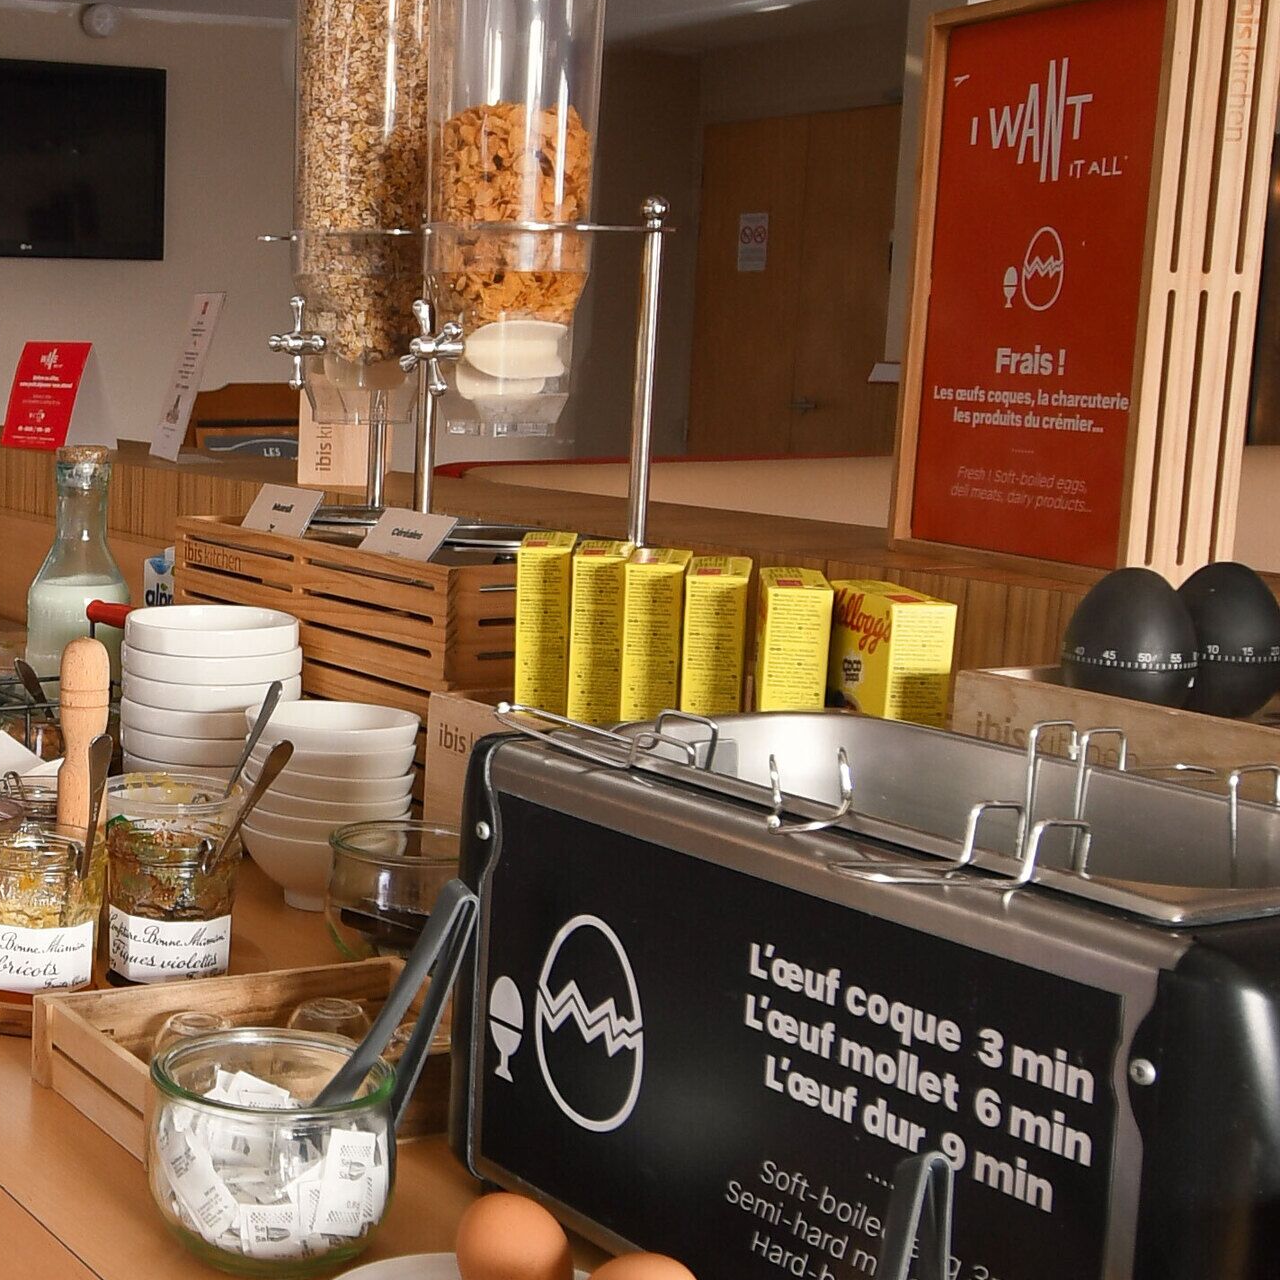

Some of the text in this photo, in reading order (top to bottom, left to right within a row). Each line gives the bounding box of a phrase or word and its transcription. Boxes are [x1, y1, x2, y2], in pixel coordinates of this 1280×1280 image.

[970, 57, 1093, 183] I WANT
[1069, 159, 1085, 179] IT
[995, 345, 1053, 376] Frais
[933, 385, 954, 401] Les
[955, 387, 986, 403] œufs
[987, 389, 1036, 408] coques,
[1037, 389, 1050, 406] la
[953, 406, 971, 423] les
[972, 408, 1023, 429] produits
[1024, 411, 1041, 428] du
[315, 443, 333, 471] ibis
[957, 465, 986, 482] Fresh
[995, 469, 1056, 489] Soft-boiled
[1007, 490, 1034, 506] dairy
[184, 540, 242, 572] ibis kitchen
[1102, 649, 1118, 661] 45
[1137, 652, 1152, 664] 50
[1170, 652, 1183, 664] 55
[1206, 644, 1220, 655] 10
[1241, 646, 1254, 657] 15
[439, 722, 466, 754] ibis
[0, 931, 41, 954] Bonne
[160, 952, 218, 970] violettes
[845, 985, 962, 1052] coque
[977, 1028, 1005, 1069] 3
[1011, 1044, 1095, 1104] min
[839, 1036, 960, 1112] mollet
[974, 1087, 1002, 1128] 6
[1009, 1104, 1093, 1167] min
[863, 1097, 926, 1154] dur
[940, 1132, 966, 1171] 9
[974, 1150, 1054, 1214] min
[760, 1160, 885, 1241] Soft-boile
[726, 1181, 849, 1261] Semi-hard
